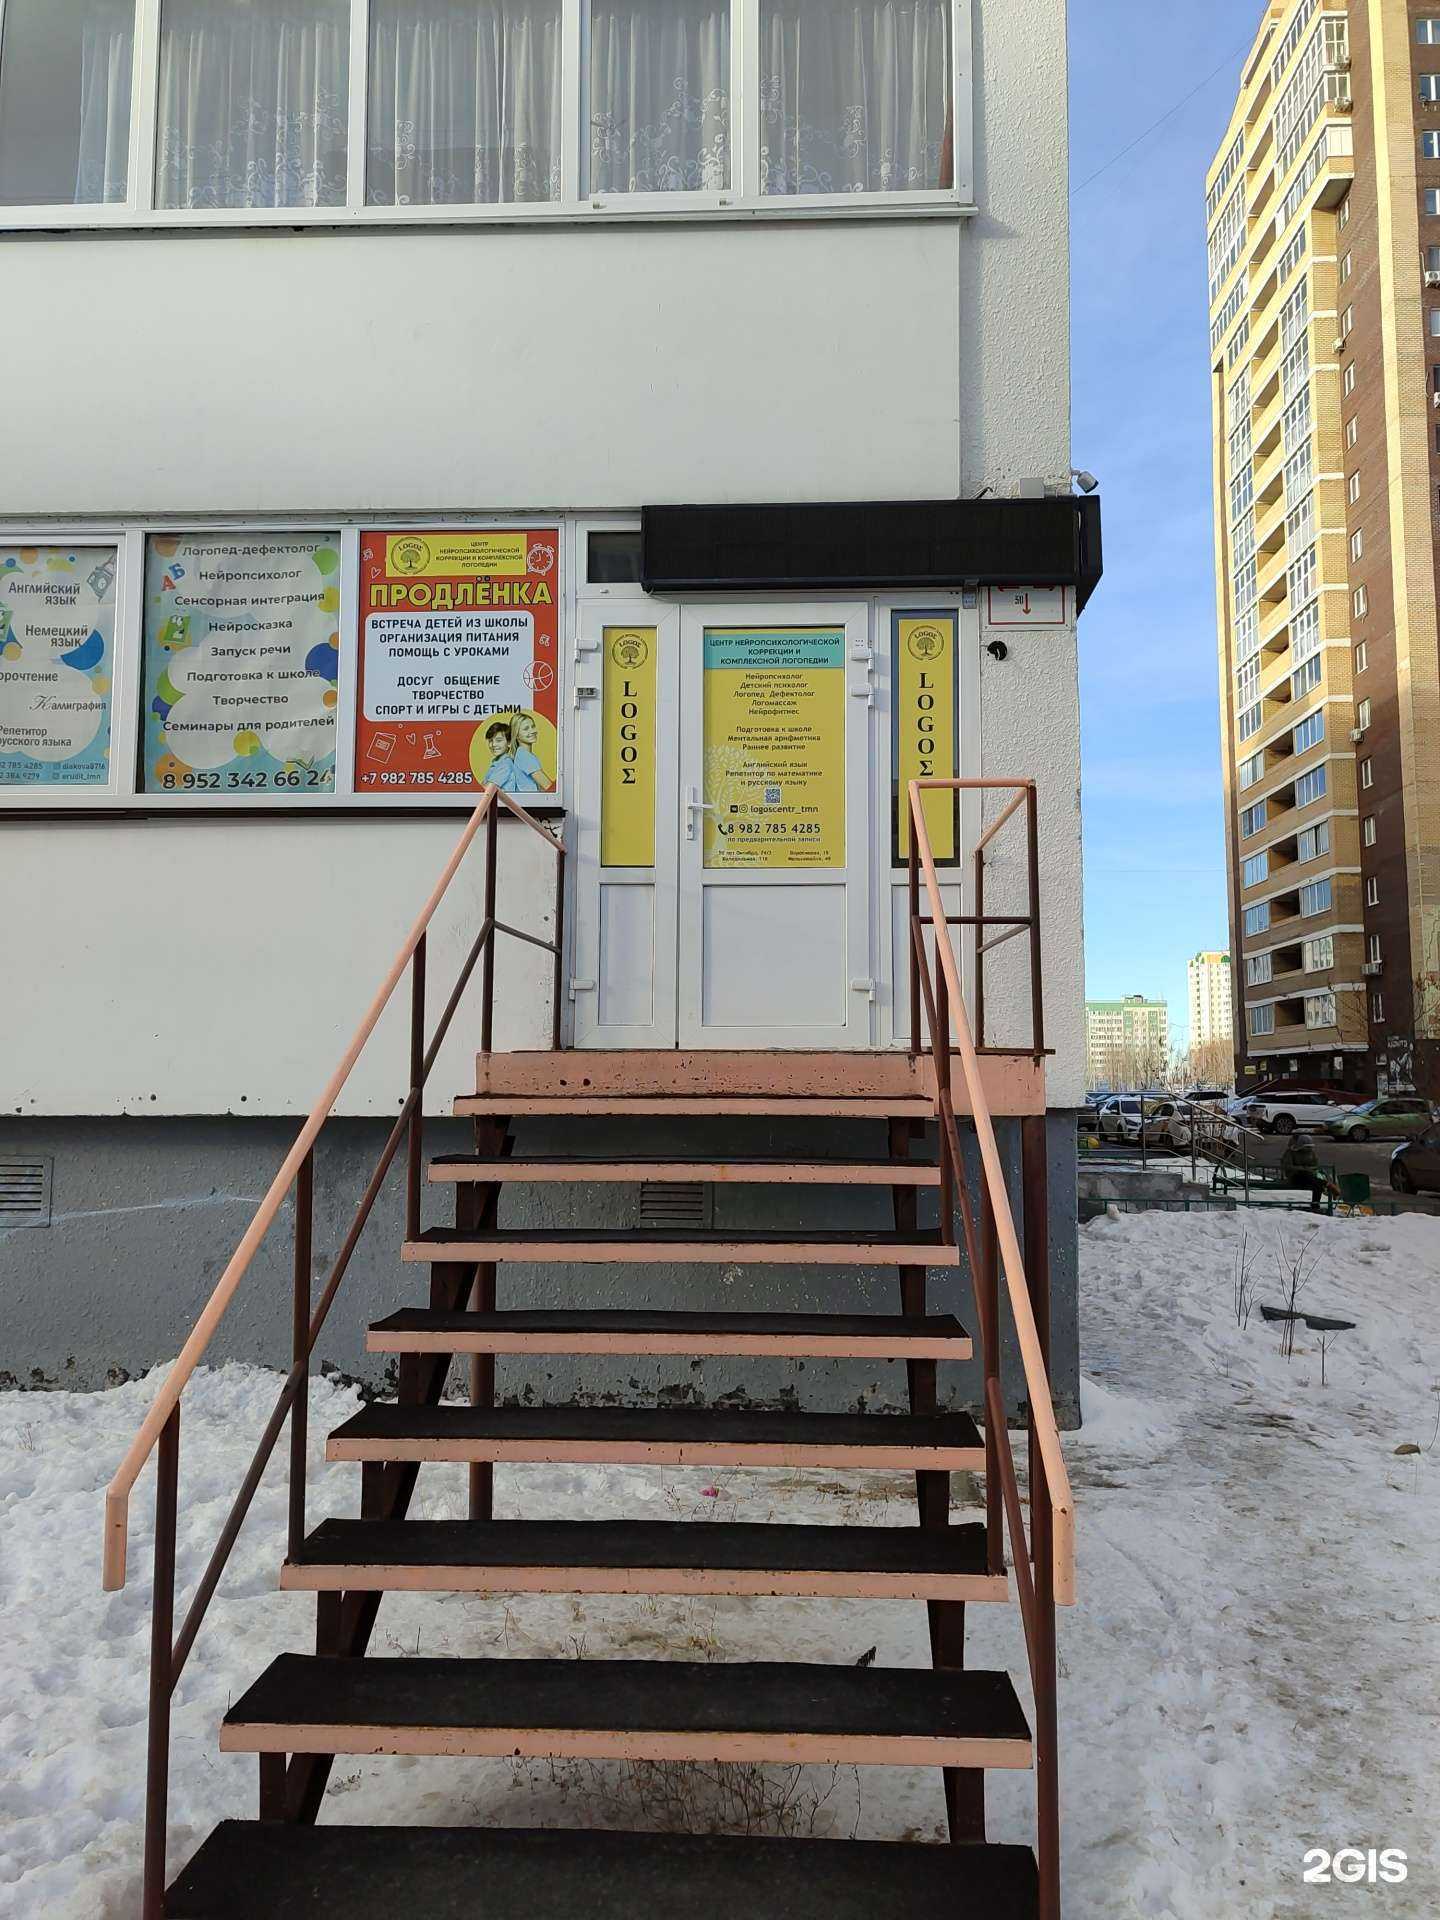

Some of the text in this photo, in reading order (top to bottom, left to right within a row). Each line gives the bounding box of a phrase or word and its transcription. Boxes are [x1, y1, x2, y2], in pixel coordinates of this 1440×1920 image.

[182, 543, 321, 557] Логопед-дефектолог
[199, 569, 302, 582] Нейропсихолог
[8, 581, 80, 595] Английский
[369, 576, 553, 611] ПРОДЛЁНКА
[45, 595, 77, 606] язык
[175, 592, 325, 608] Сенсорная интеграция
[208, 618, 293, 633] Нейросказка
[371, 616, 528, 630] ВСТРЕЧА ДЕТЕЙ ИЗ ШКОЛЫ
[25, 624, 88, 637] Немецкий
[50, 637, 82, 648] язык
[379, 632, 519, 644] ОРГАНИЗАЦИЯ ПИТАНИЯ
[735, 638, 840, 646] НЕЙРОПСИХОЛОГИЧЕСКОЙ
[211, 645, 291, 658] Запуск речи
[388, 646, 510, 659] ПОМОЩЬ С УРОКАМИ
[720, 657, 829, 665] КОМПЛЕКСНОЙ ЛОГОПЕДИИ
[187, 672, 263, 683] Подготовка
[278, 670, 320, 679] школе
[397, 675, 500, 688] ДОСУГ ОБЩЕНИЕ
[740, 682, 772, 690] Детский
[212, 695, 289, 706] Творчество
[412, 690, 484, 700] ТВОРЧЕСТВО
[29, 695, 107, 711] Каллиграфия
[375, 704, 522, 715] СПОРТ И ИГРЫ С ДЕТЬМИ
[748, 707, 800, 716] Нейрофитнес
[163, 715, 335, 732] Семинары для родителей
[917, 672, 935, 776] LOGOΣ
[620, 681, 638, 784] LOGOΣ
[736, 726, 780, 734] Подготовка
[42, 738, 72, 747] языка
[774, 735, 821, 743] арифметика
[743, 760, 788, 768] Английский
[162, 773, 176, 789] 8
[182, 772, 220, 789] 952
[227, 772, 268, 788] 342
[273, 770, 300, 787] 66
[361, 772, 473, 784] +7 982 785 4285
[750, 805, 819, 815] logoscentr_tmn
[727, 823, 821, 833] 8 982 785 4285
